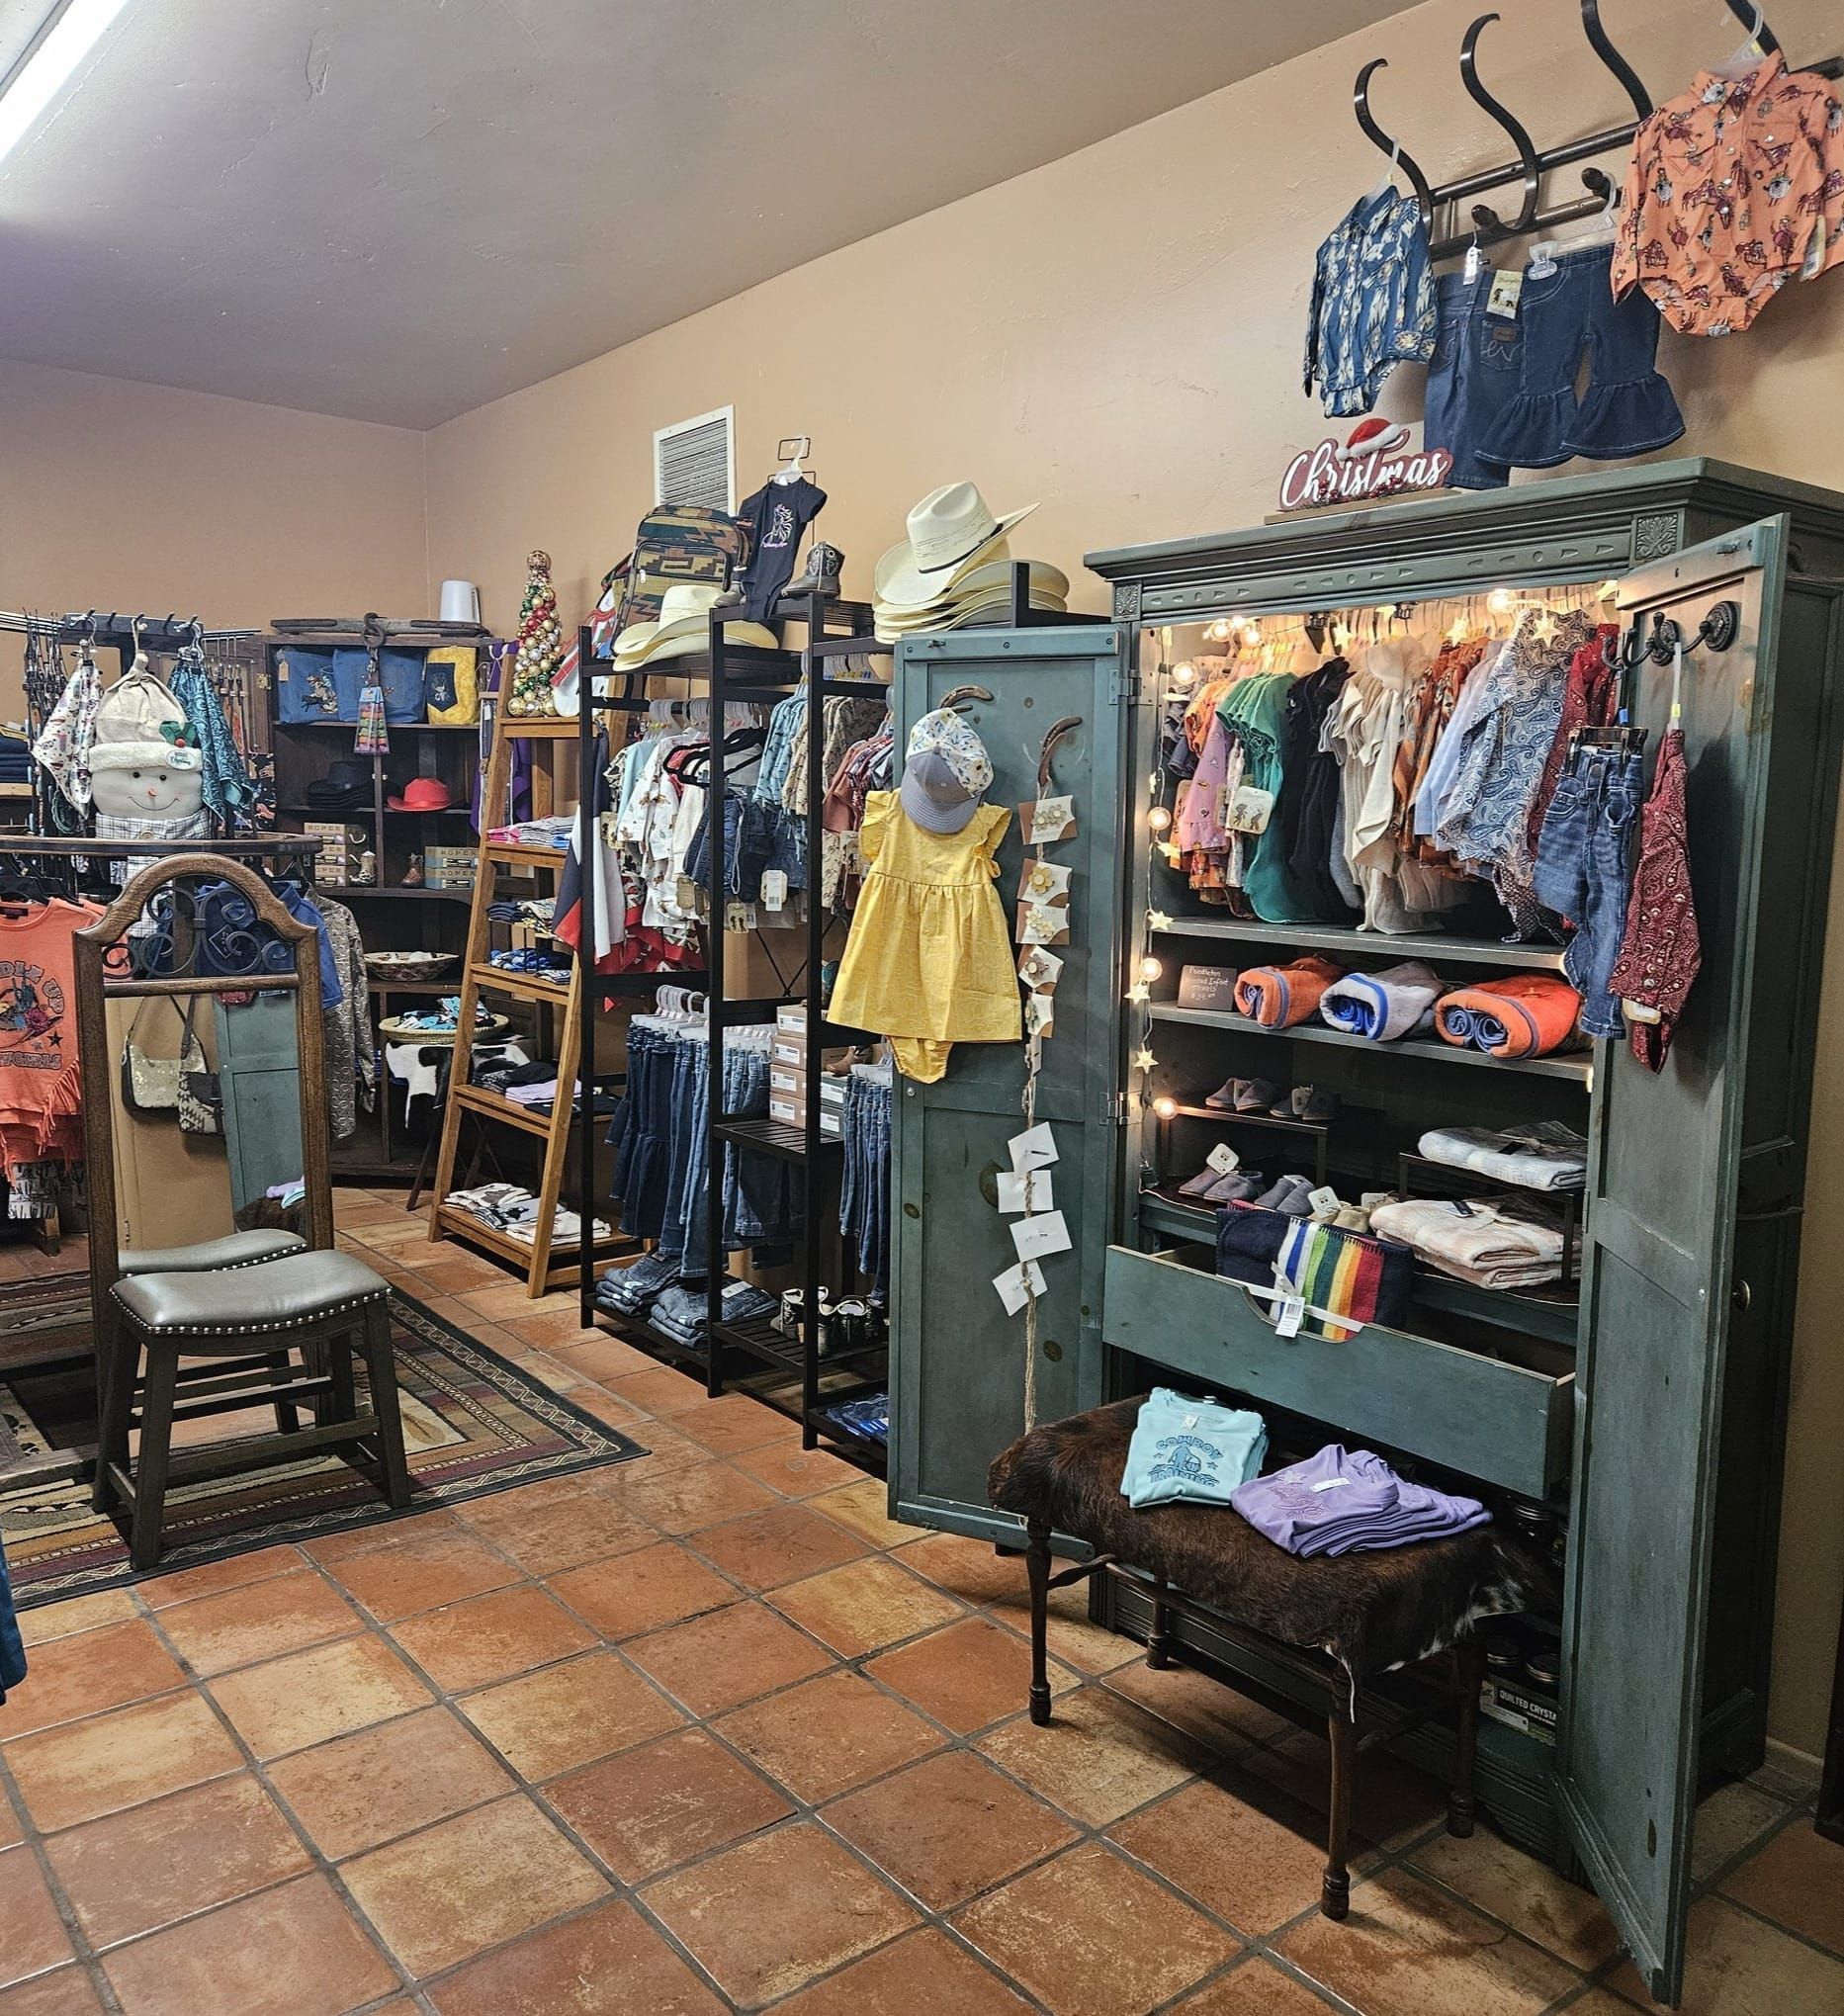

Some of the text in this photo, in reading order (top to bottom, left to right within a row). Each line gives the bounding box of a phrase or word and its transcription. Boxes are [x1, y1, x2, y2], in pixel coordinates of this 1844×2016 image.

[1280, 435, 1449, 507] Christmas
[1156, 1436, 1224, 1459] COWBOY
[1499, 1690, 1529, 1709] QUILTED
[1530, 1703, 1557, 1720] CRYSTA
